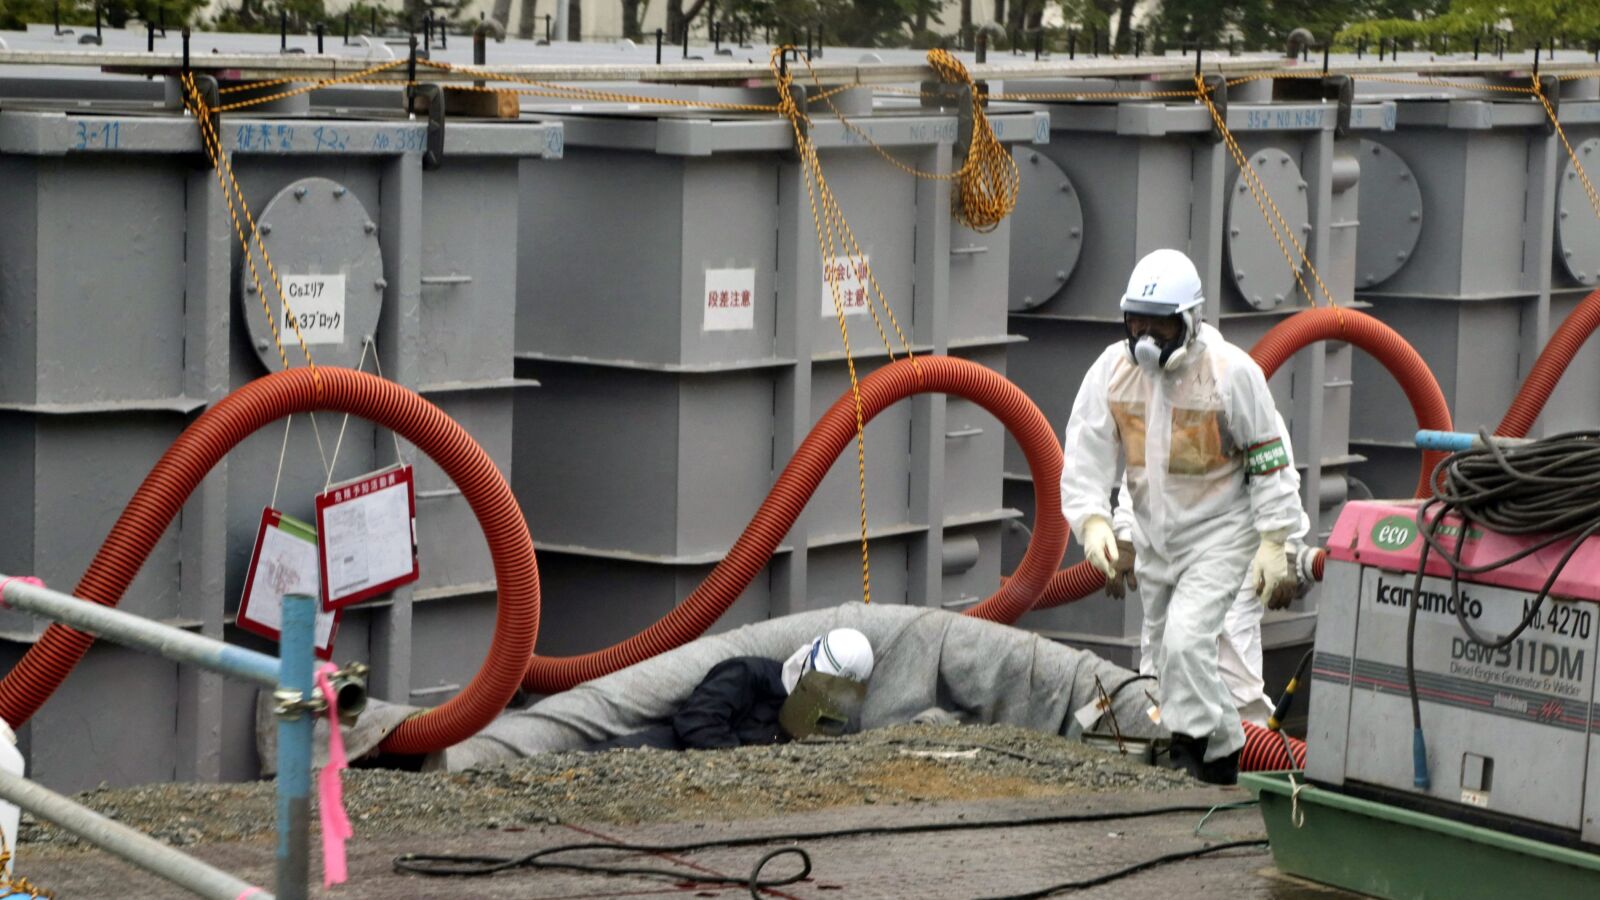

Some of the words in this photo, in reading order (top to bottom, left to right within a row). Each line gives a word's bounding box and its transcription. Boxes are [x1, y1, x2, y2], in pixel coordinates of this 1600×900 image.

[76, 121, 120, 150] 3-11
[707, 289, 752, 309] 段差注意
[842, 287, 865, 308] 注意
[1378, 524, 1409, 545] eco
[1449, 660, 1474, 678] Diesel
[1501, 670, 1541, 691] Generator
